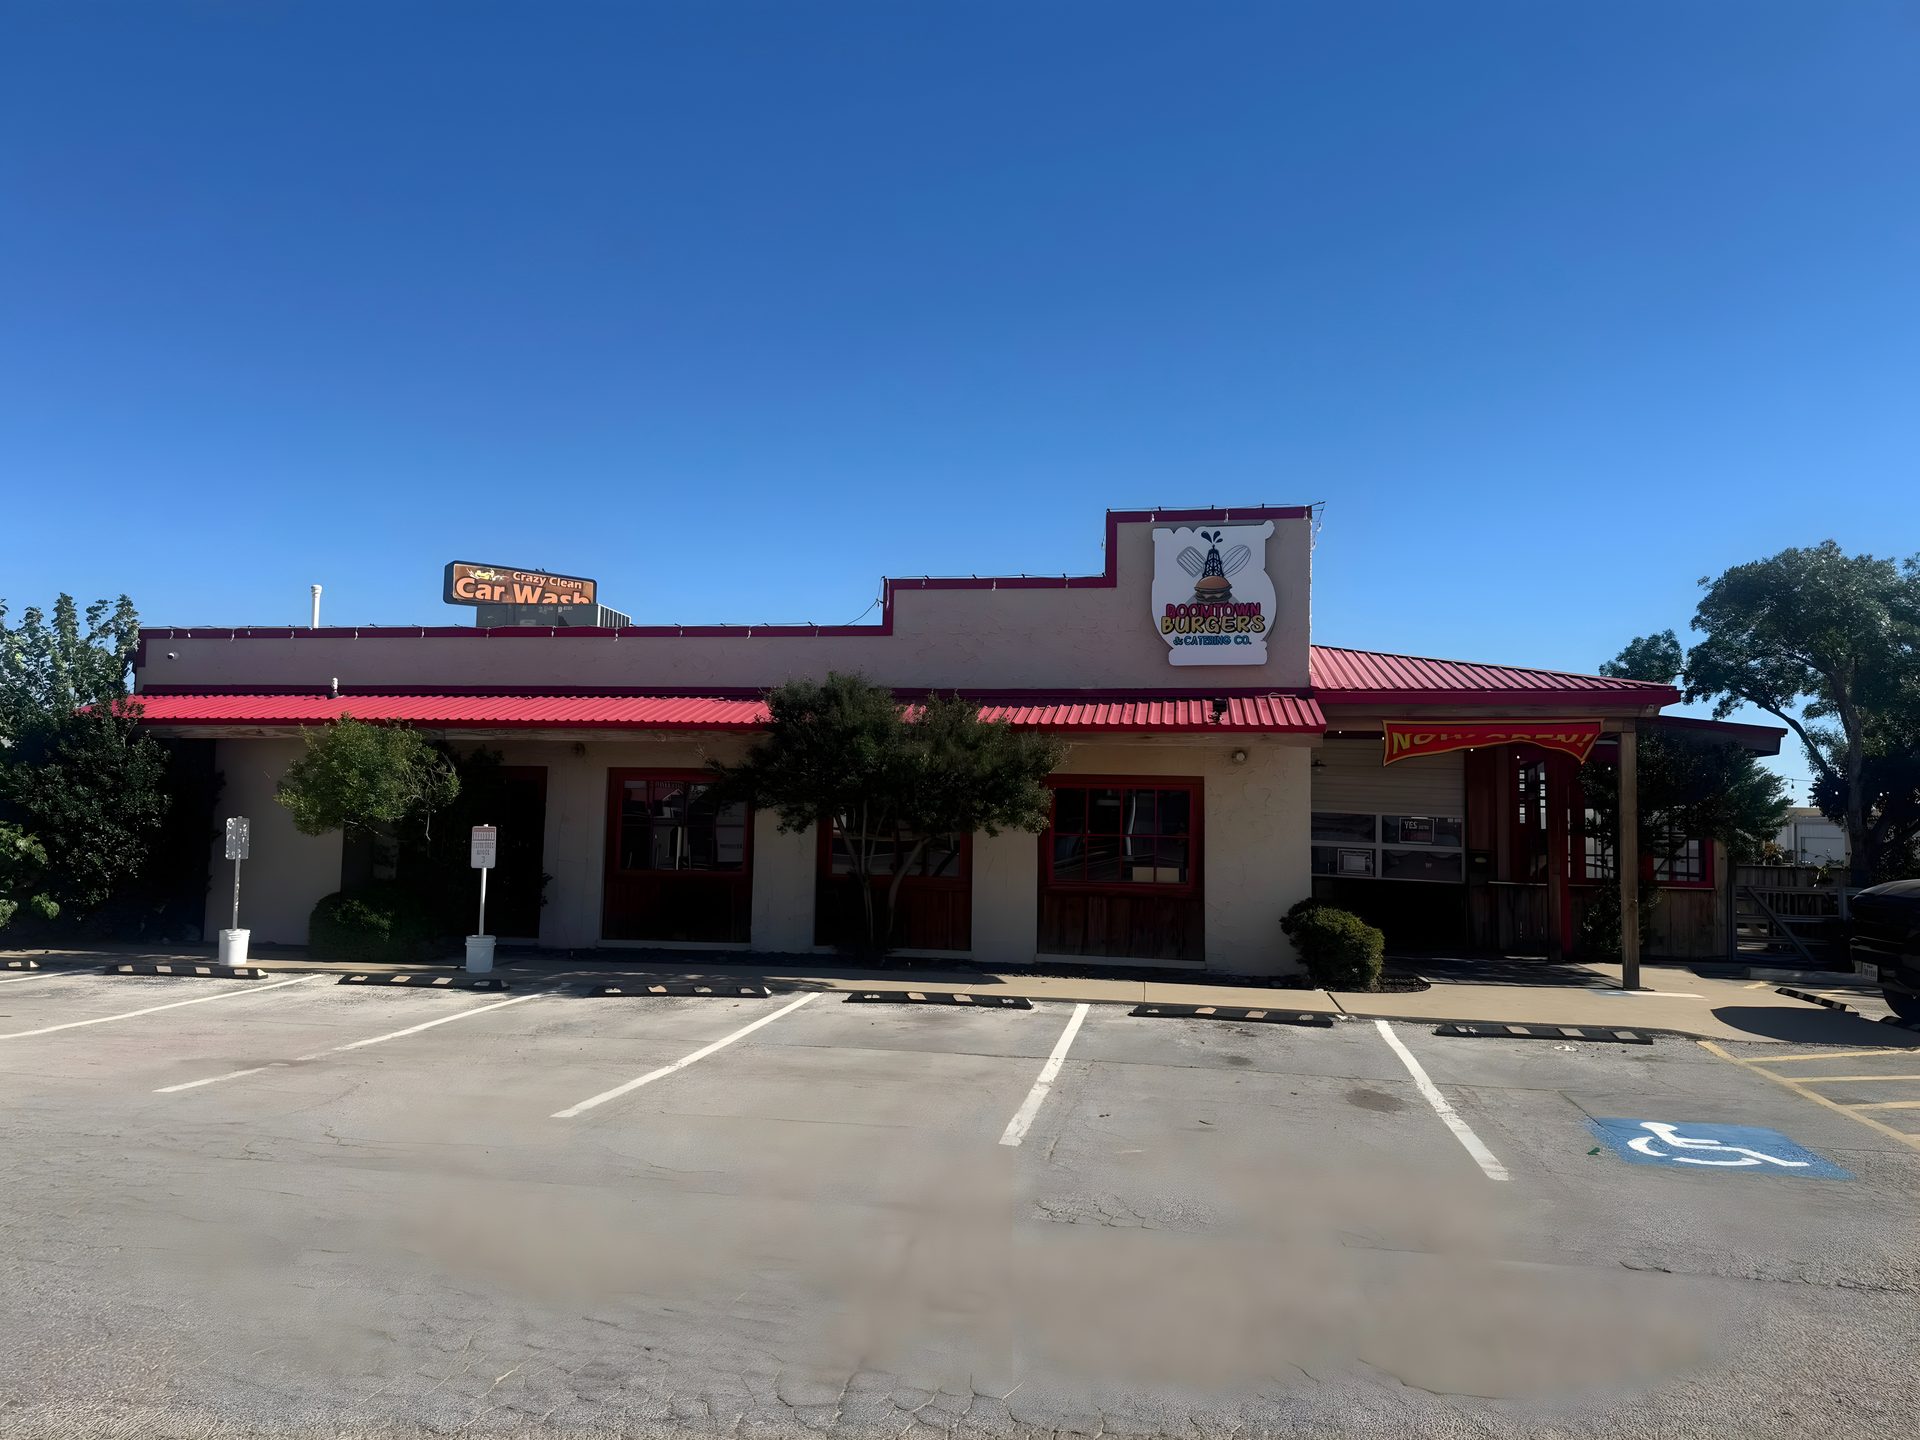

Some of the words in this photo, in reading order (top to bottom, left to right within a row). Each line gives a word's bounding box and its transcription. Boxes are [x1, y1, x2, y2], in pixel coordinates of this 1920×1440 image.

[512, 571, 550, 587] Crazy
[549, 576, 582, 589] Clean
[456, 577, 505, 601] Car
[512, 583, 591, 604] Wash
[1165, 602, 1261, 618] BOOMTOWN
[1160, 615, 1265, 634] BURGERS
[1233, 635, 1252, 645] CO.
[1404, 820, 1418, 829] YES
